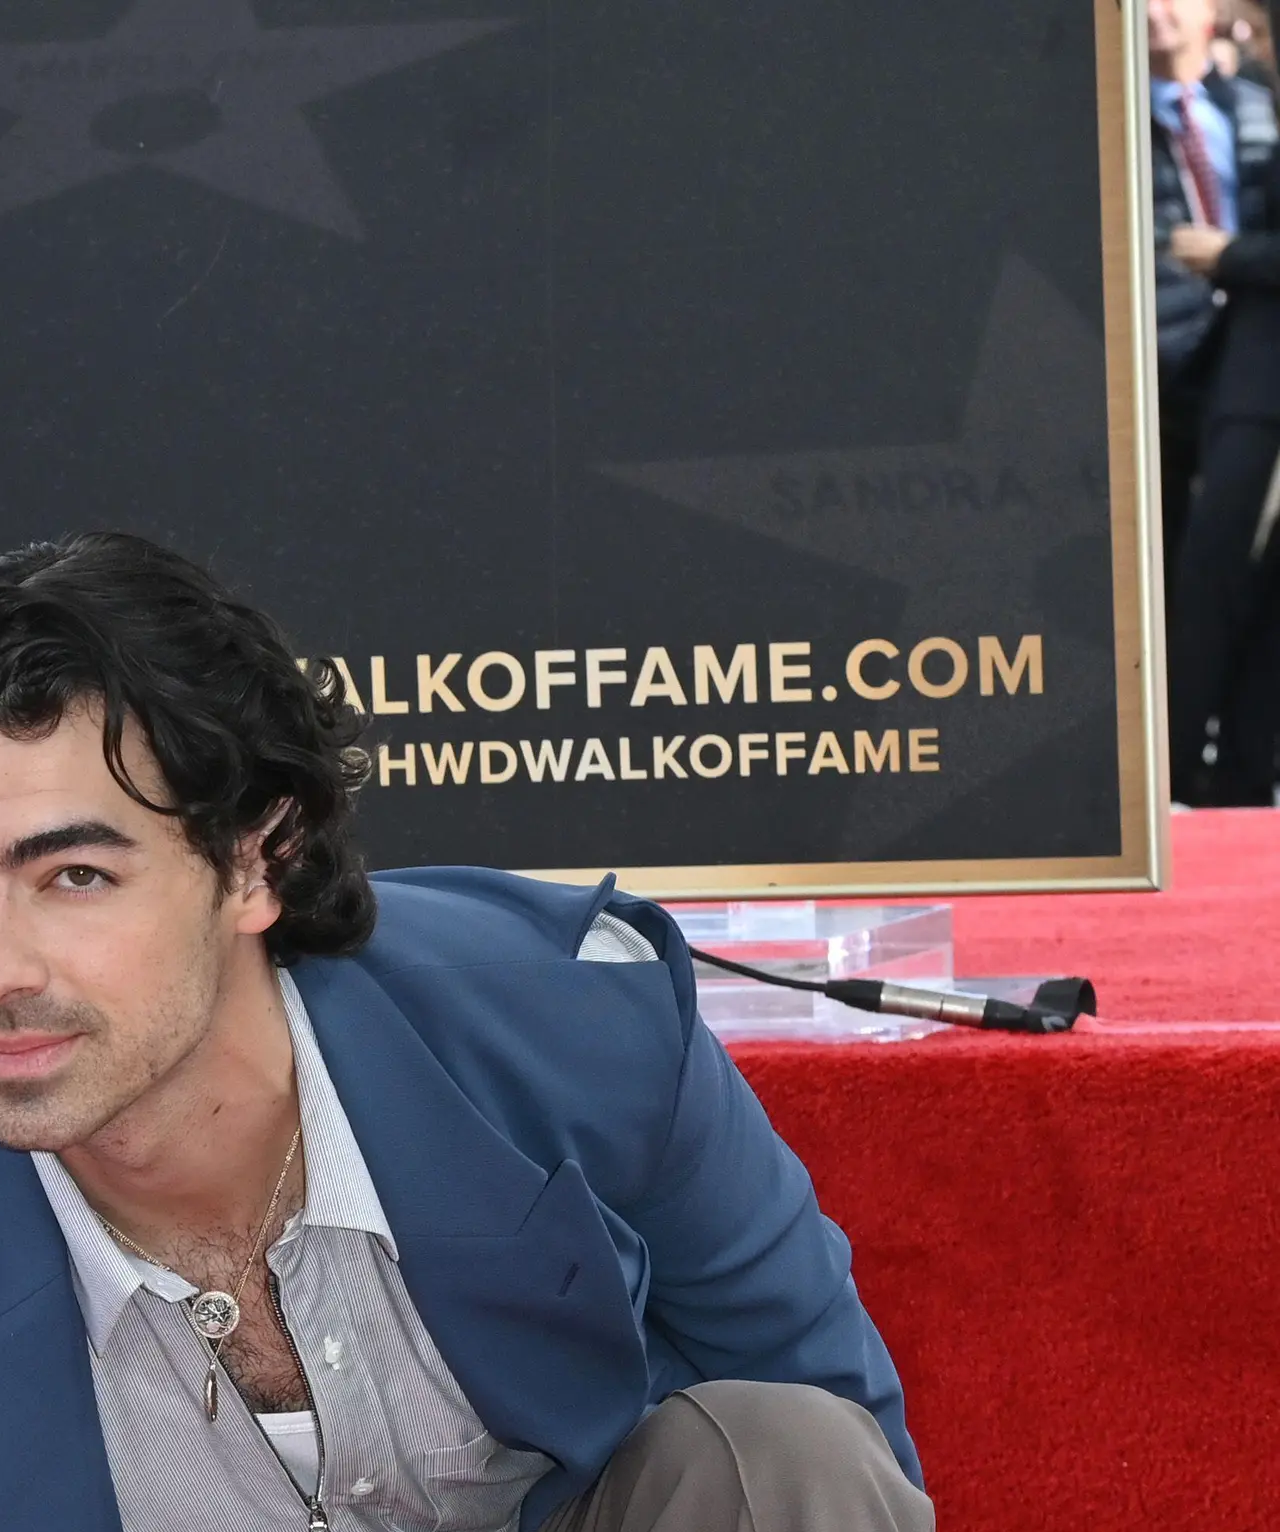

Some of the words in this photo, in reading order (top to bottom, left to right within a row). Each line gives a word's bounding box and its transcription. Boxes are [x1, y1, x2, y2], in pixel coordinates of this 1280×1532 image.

[770, 466, 1033, 520] SANDRA
[295, 634, 1043, 715] ALKOFFAME.COM
[342, 728, 941, 790] HWDWALKOFFAME
